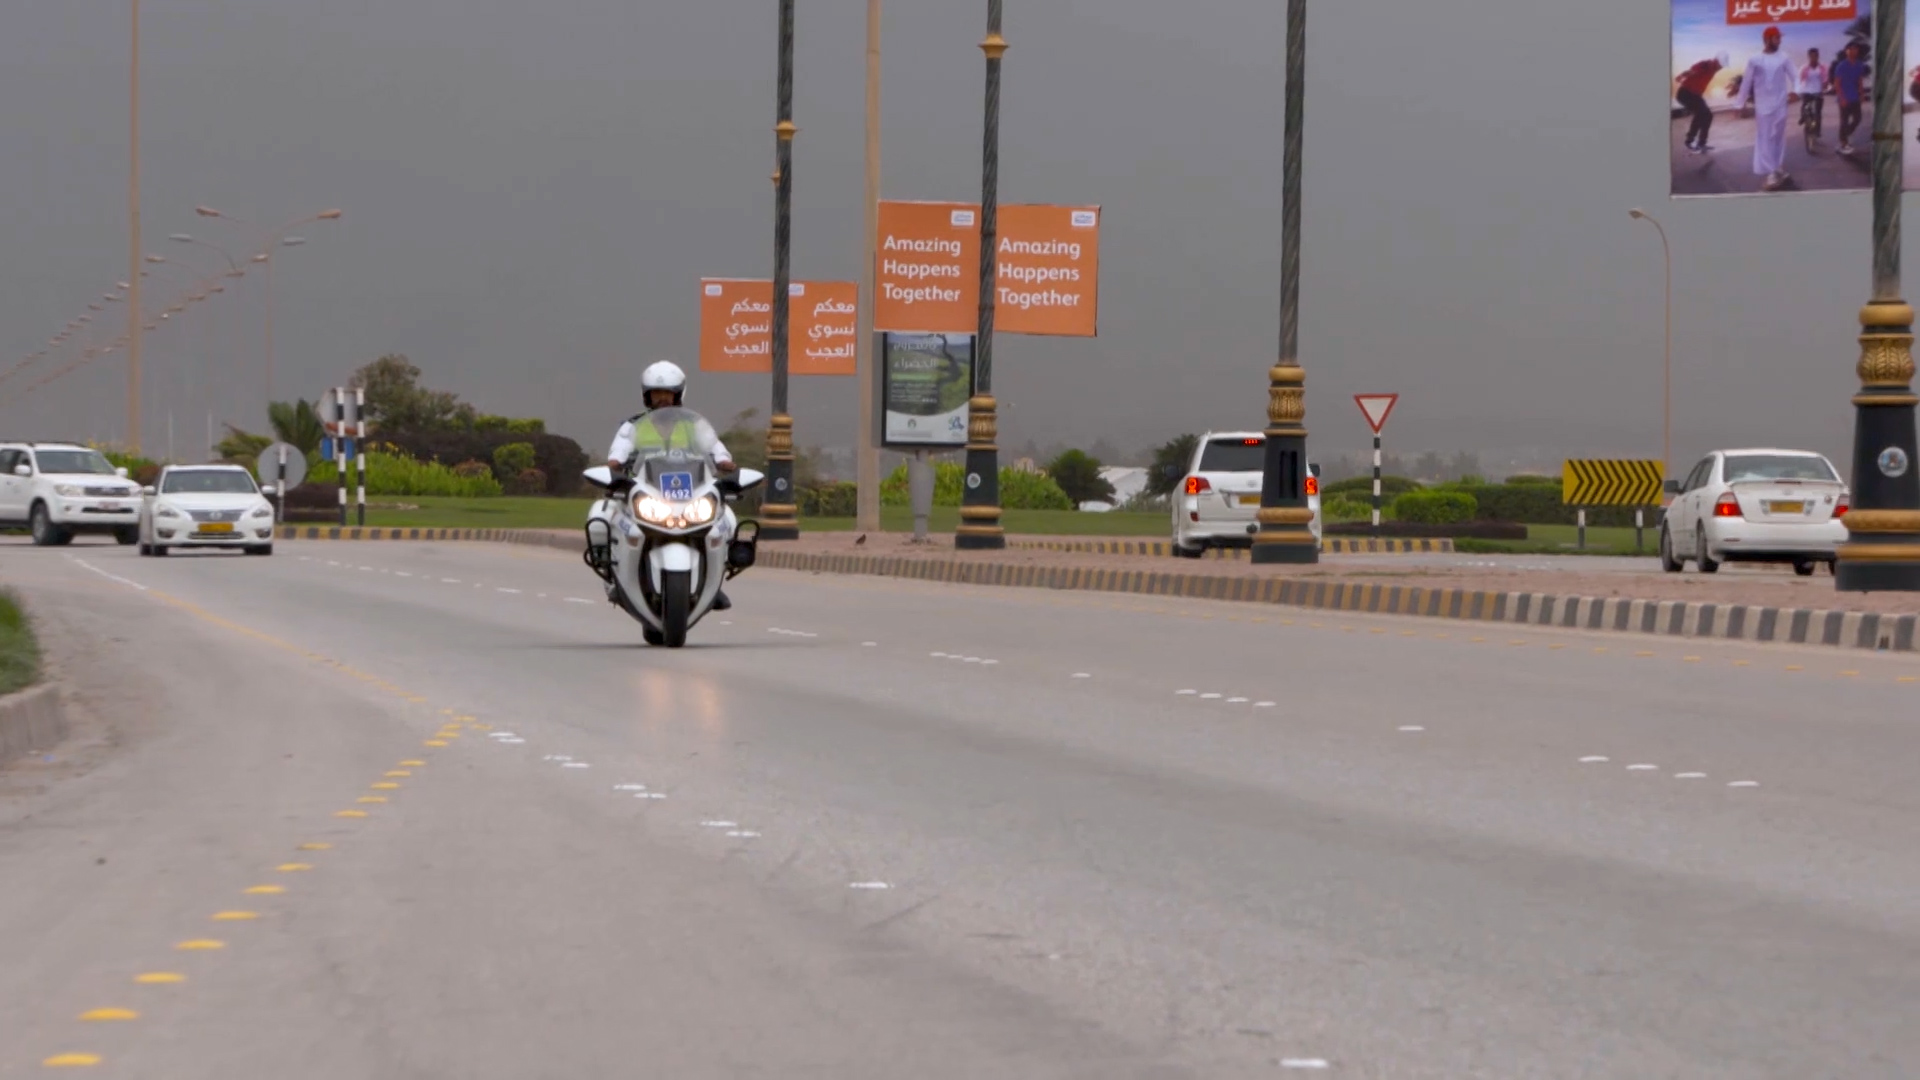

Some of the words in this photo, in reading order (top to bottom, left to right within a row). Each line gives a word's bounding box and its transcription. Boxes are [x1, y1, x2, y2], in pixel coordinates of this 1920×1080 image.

[883, 234, 961, 257] Amazing
[998, 236, 1081, 260] Amazing
[883, 258, 961, 279] Happens
[998, 262, 1080, 284] Happens
[882, 282, 961, 305] Together
[997, 287, 1080, 310] Together
[731, 298, 770, 316] معكم
[813, 298, 856, 318] معكم
[725, 320, 770, 341] نسوي
[808, 320, 855, 342] نسوي
[723, 340, 770, 358] العجب
[805, 342, 855, 361] العجب
